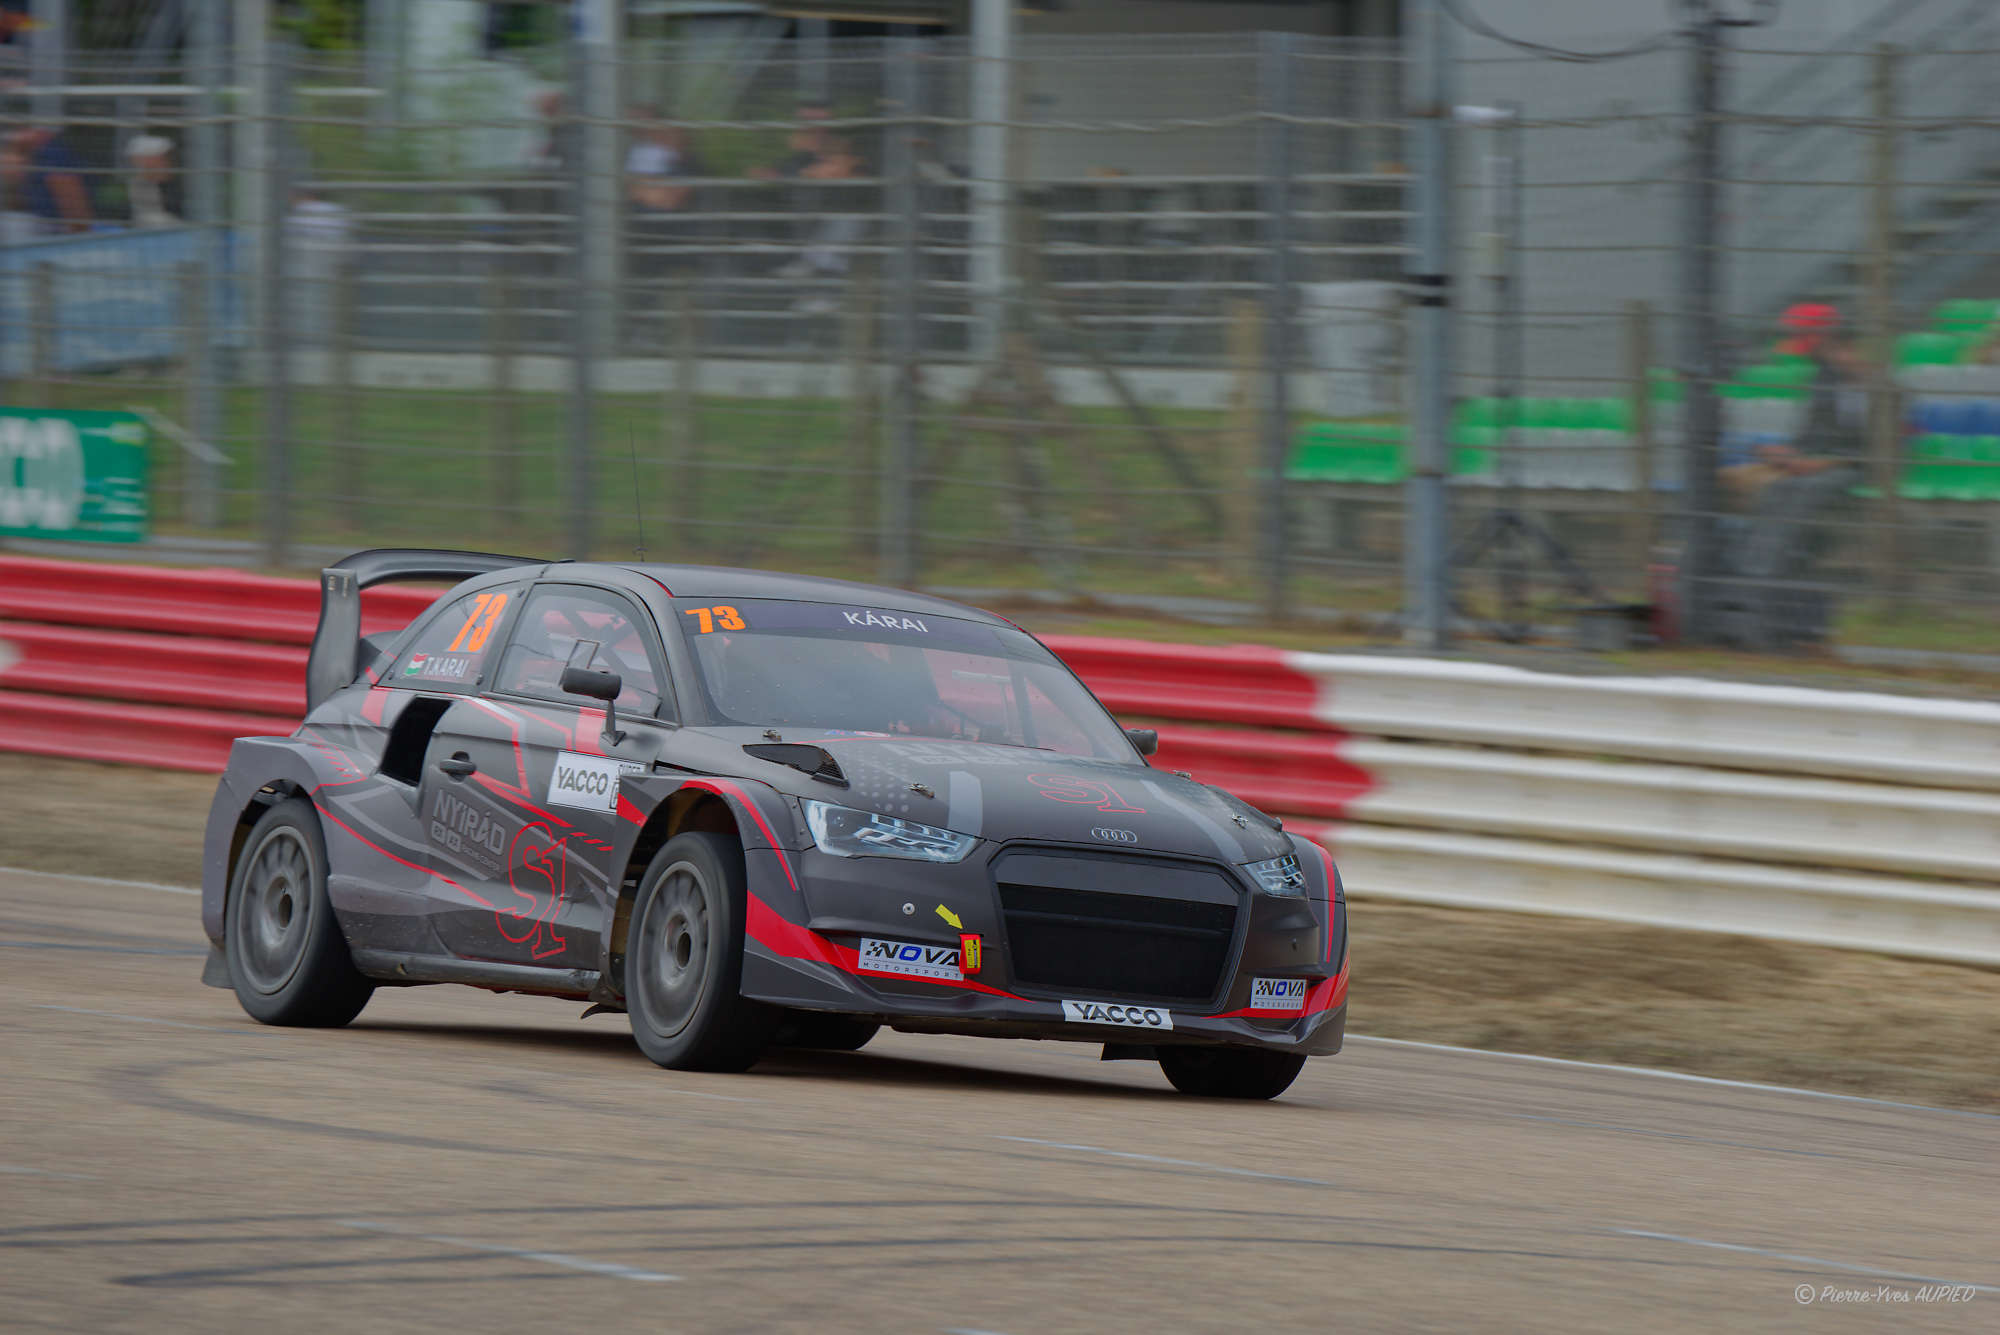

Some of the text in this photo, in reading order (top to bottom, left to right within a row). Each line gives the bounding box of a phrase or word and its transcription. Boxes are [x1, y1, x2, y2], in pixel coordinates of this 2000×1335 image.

[447, 593, 508, 652] 73
[685, 605, 746, 634] 73
[843, 610, 928, 633] KÁRAI
[557, 765, 608, 796] YACCO
[875, 942, 960, 967] NOVA
[1261, 980, 1304, 997] NOVA
[1072, 1002, 1162, 1026] YACCO
